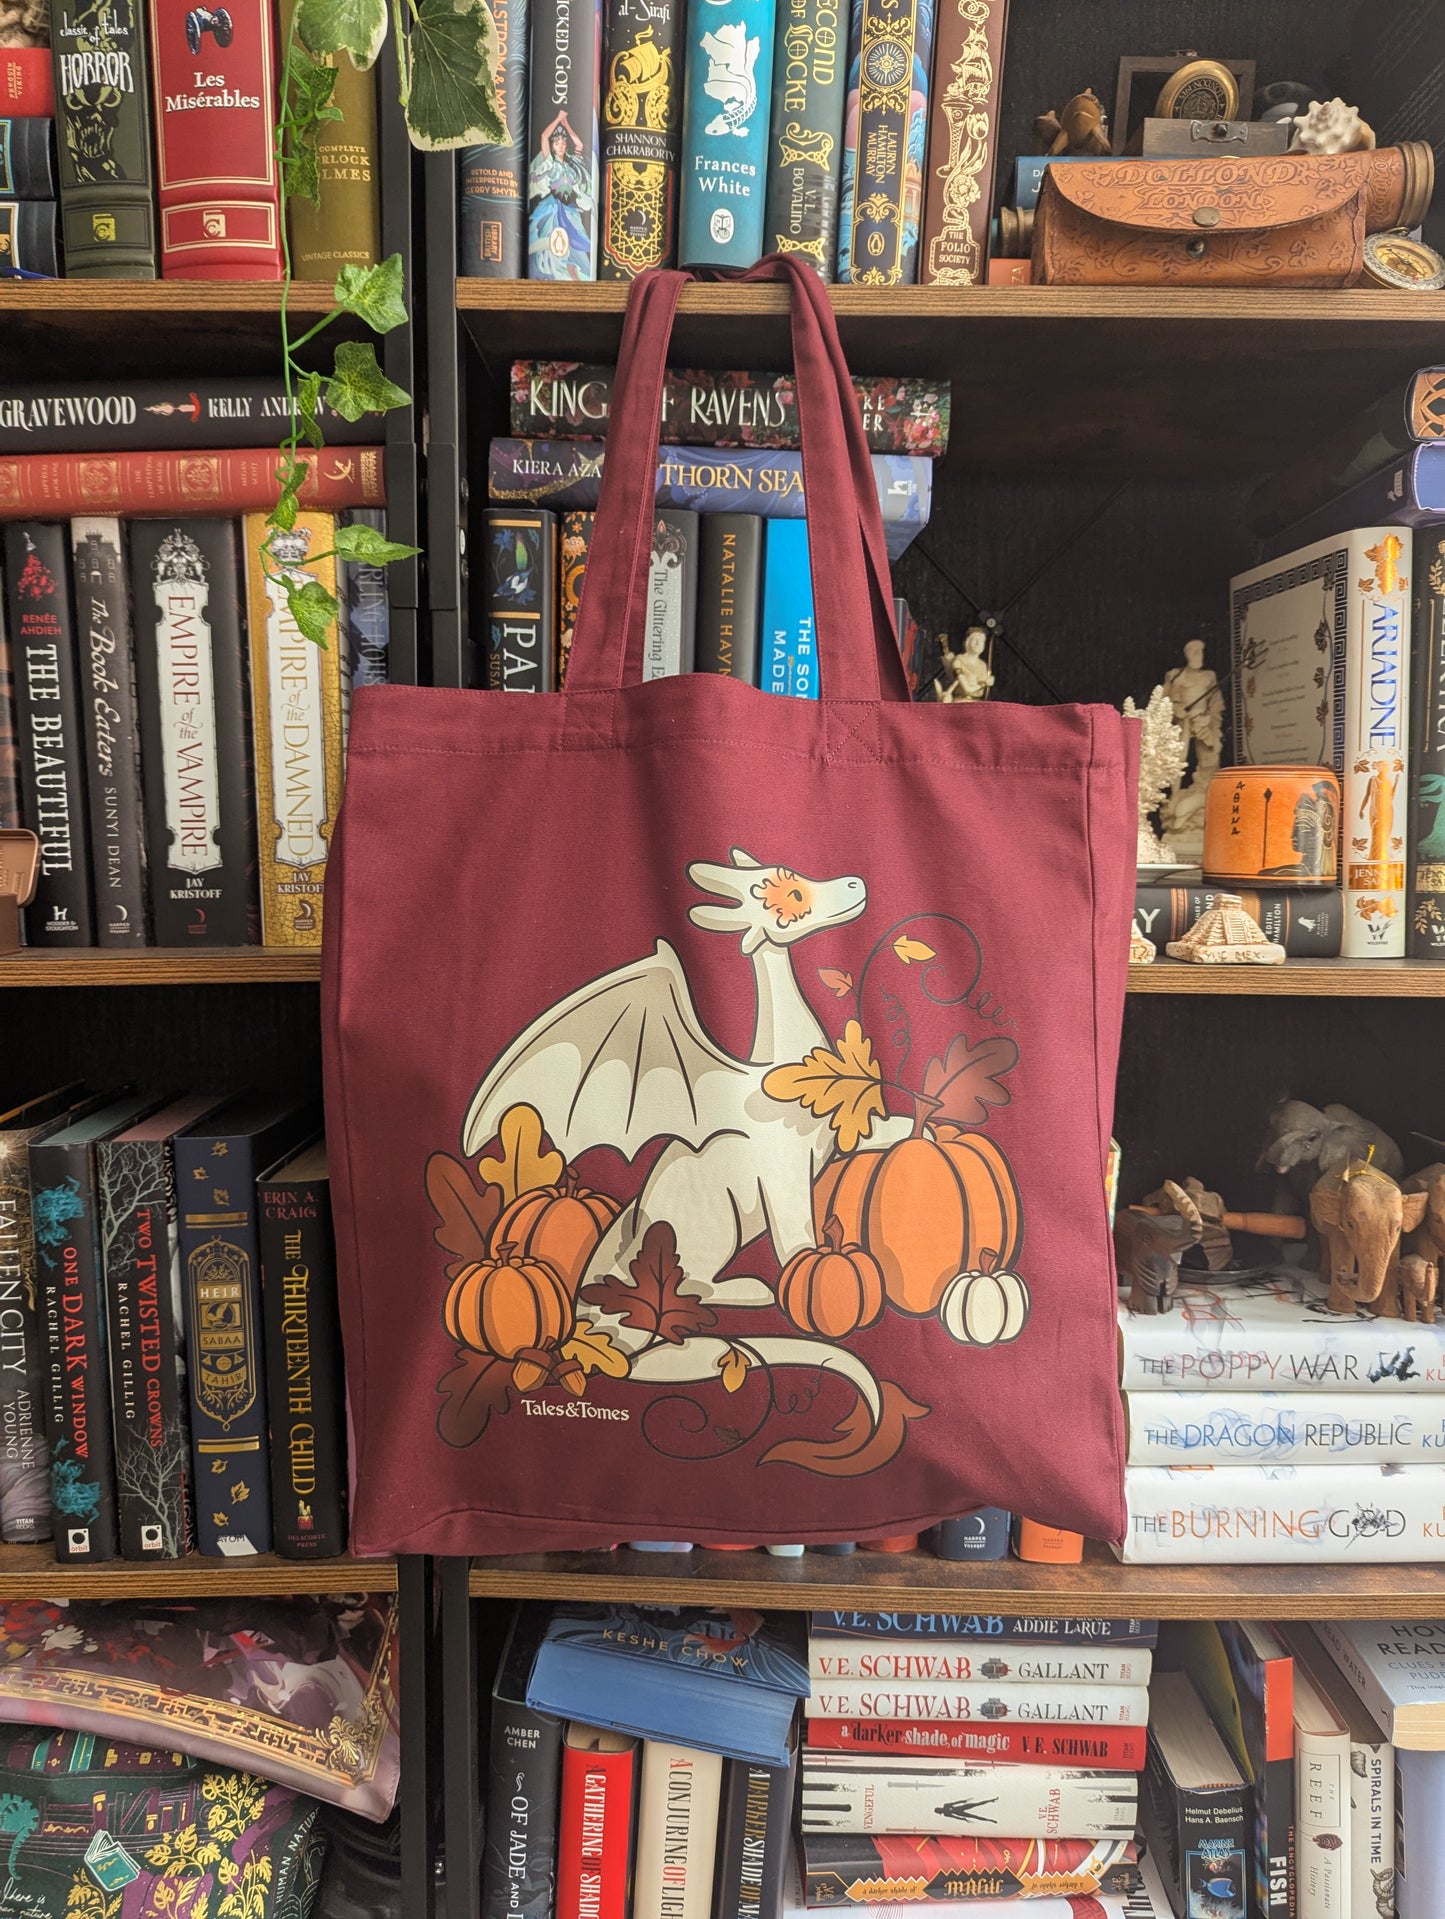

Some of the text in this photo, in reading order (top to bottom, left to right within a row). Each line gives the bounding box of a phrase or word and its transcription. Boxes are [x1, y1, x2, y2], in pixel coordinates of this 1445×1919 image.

[60, 9, 129, 37] classic tales
[89, 26, 100, 47] of
[60, 51, 134, 96] HORROR
[194, 72, 225, 88] Les
[552, 55, 571, 105] GODS
[784, 23, 813, 112] LOCKE
[165, 89, 260, 112] Misérables
[318, 145, 366, 153] COMPLETE
[606, 146, 676, 162] CHAKRABORTY
[615, 133, 667, 147] SHANNON
[865, 131, 877, 177] MURRAY
[875, 124, 888, 184] HAMILTON
[886, 132, 898, 175] LAURYN
[498, 170, 514, 178] AND
[695, 156, 756, 177] Frances
[1114, 161, 1299, 188] DOLLOND
[698, 176, 751, 197] White
[1138, 191, 1267, 210] LONDON
[790, 168, 804, 234] BOVALINO
[941, 242, 971, 253] FOLIO
[949, 231, 964, 239] THE
[302, 251, 370, 262] VINTAGE CLASSICS
[939, 254, 971, 264] SOCIETY
[0, 396, 252, 432] GRAVEWOOD KELLY
[529, 380, 786, 428] KING RAVENS
[513, 459, 563, 475] KIERA
[660, 463, 754, 490] THORN
[654, 569, 668, 594] The
[720, 534, 736, 617] NATALIE
[20, 625, 62, 635] AHDIEH
[22, 612, 58, 624] RENÉE
[648, 600, 667, 662] Glittering
[167, 594, 201, 706] EMPIRE
[797, 616, 811, 656] THE
[89, 626, 119, 693] Book
[1369, 602, 1400, 750] ARIADNE
[286, 709, 305, 721] the
[94, 697, 121, 777] Eaters
[179, 727, 198, 739] the
[26, 643, 72, 876] THE BEAUTIFUL
[177, 741, 208, 858] VAMPIRE
[283, 724, 314, 857] DAMNED
[103, 786, 120, 838] SUNYI
[107, 843, 122, 888] DEAN
[293, 873, 310, 883] JAY
[170, 889, 222, 899] KRISTOFF
[186, 877, 205, 888] JAY
[1265, 911, 1273, 934] EDITH
[1273, 903, 1281, 943] HAMILTON
[263, 1191, 298, 1205] ERIN
[265, 1206, 318, 1220] CRAIG
[200, 1287, 239, 1298] HEIR
[136, 1208, 162, 1448] TWO TWISTED CROWNS
[203, 1335, 241, 1345] SABAA
[0, 1309, 27, 1376] CITY
[46, 1286, 64, 1423] RACHEL GILLIG
[62, 1246, 88, 1458] ONE DARK WINDOW
[117, 1281, 136, 1420] RACHEL GILLIG
[282, 1229, 315, 1495] THE THIRTEENTH CHILD
[1140, 1354, 1359, 1380] THE POPPY WAR
[205, 1372, 243, 1385] TAHIR
[521, 1399, 630, 1421] Tales&Tomes
[3, 1401, 19, 1459] YOUNG
[17, 1389, 36, 1469] ADRIENNE
[1144, 1423, 1413, 1447] THE DRAGON REPUBLIC
[1132, 1508, 1407, 1539] THE BURNING GOD
[217, 1534, 245, 1543] ATOM
[876, 1611, 1005, 1635] SCHWAB
[1012, 1620, 1058, 1634] ADDIE
[602, 1628, 749, 1668] KESHE CHOW
[858, 1654, 1109, 1679] SCHWAB GALLANT
[1119, 1663, 1127, 1679] TITAN
[1342, 1649, 1367, 1691] WATER
[1388, 1661, 1434, 1670] CLUES
[858, 1693, 1109, 1721] SCHWAB GALLANT
[504, 1725, 541, 1739] AMBER
[507, 1737, 537, 1750] CHEN
[841, 1721, 1108, 1758] a darker shade of magic SCHWAB
[1309, 1762, 1322, 1819] REEF
[510, 1796, 529, 1826] OF
[581, 1773, 606, 1857] GATHERING
[863, 1784, 875, 1829] VENGEFUL
[1047, 1788, 1060, 1834] SCHWAB
[1185, 1806, 1243, 1815] Helmut Debelius
[1185, 1815, 1243, 1824] Hans A. Baensch
[1370, 1758, 1382, 1864] SPIRALS IN TIME
[662, 1757, 693, 1886] A CONJURING OF
[739, 1767, 771, 1903] A DARKER SHADE OF
[508, 1829, 527, 1880] JADE
[1198, 1838, 1235, 1849] MARINE
[1201, 1847, 1232, 1860] ATLAS
[276, 1856, 291, 1902] HUMAN
[581, 1857, 602, 1874] OF
[868, 1886, 889, 1895] darker
[1269, 1855, 1287, 1906] FISH
[1288, 1846, 1296, 1917] ENCYCLOPEDIA
[1309, 1865, 1319, 1897] History
[1324, 1867, 1333, 1909] Passionate
[510, 1882, 520, 1909] AND
